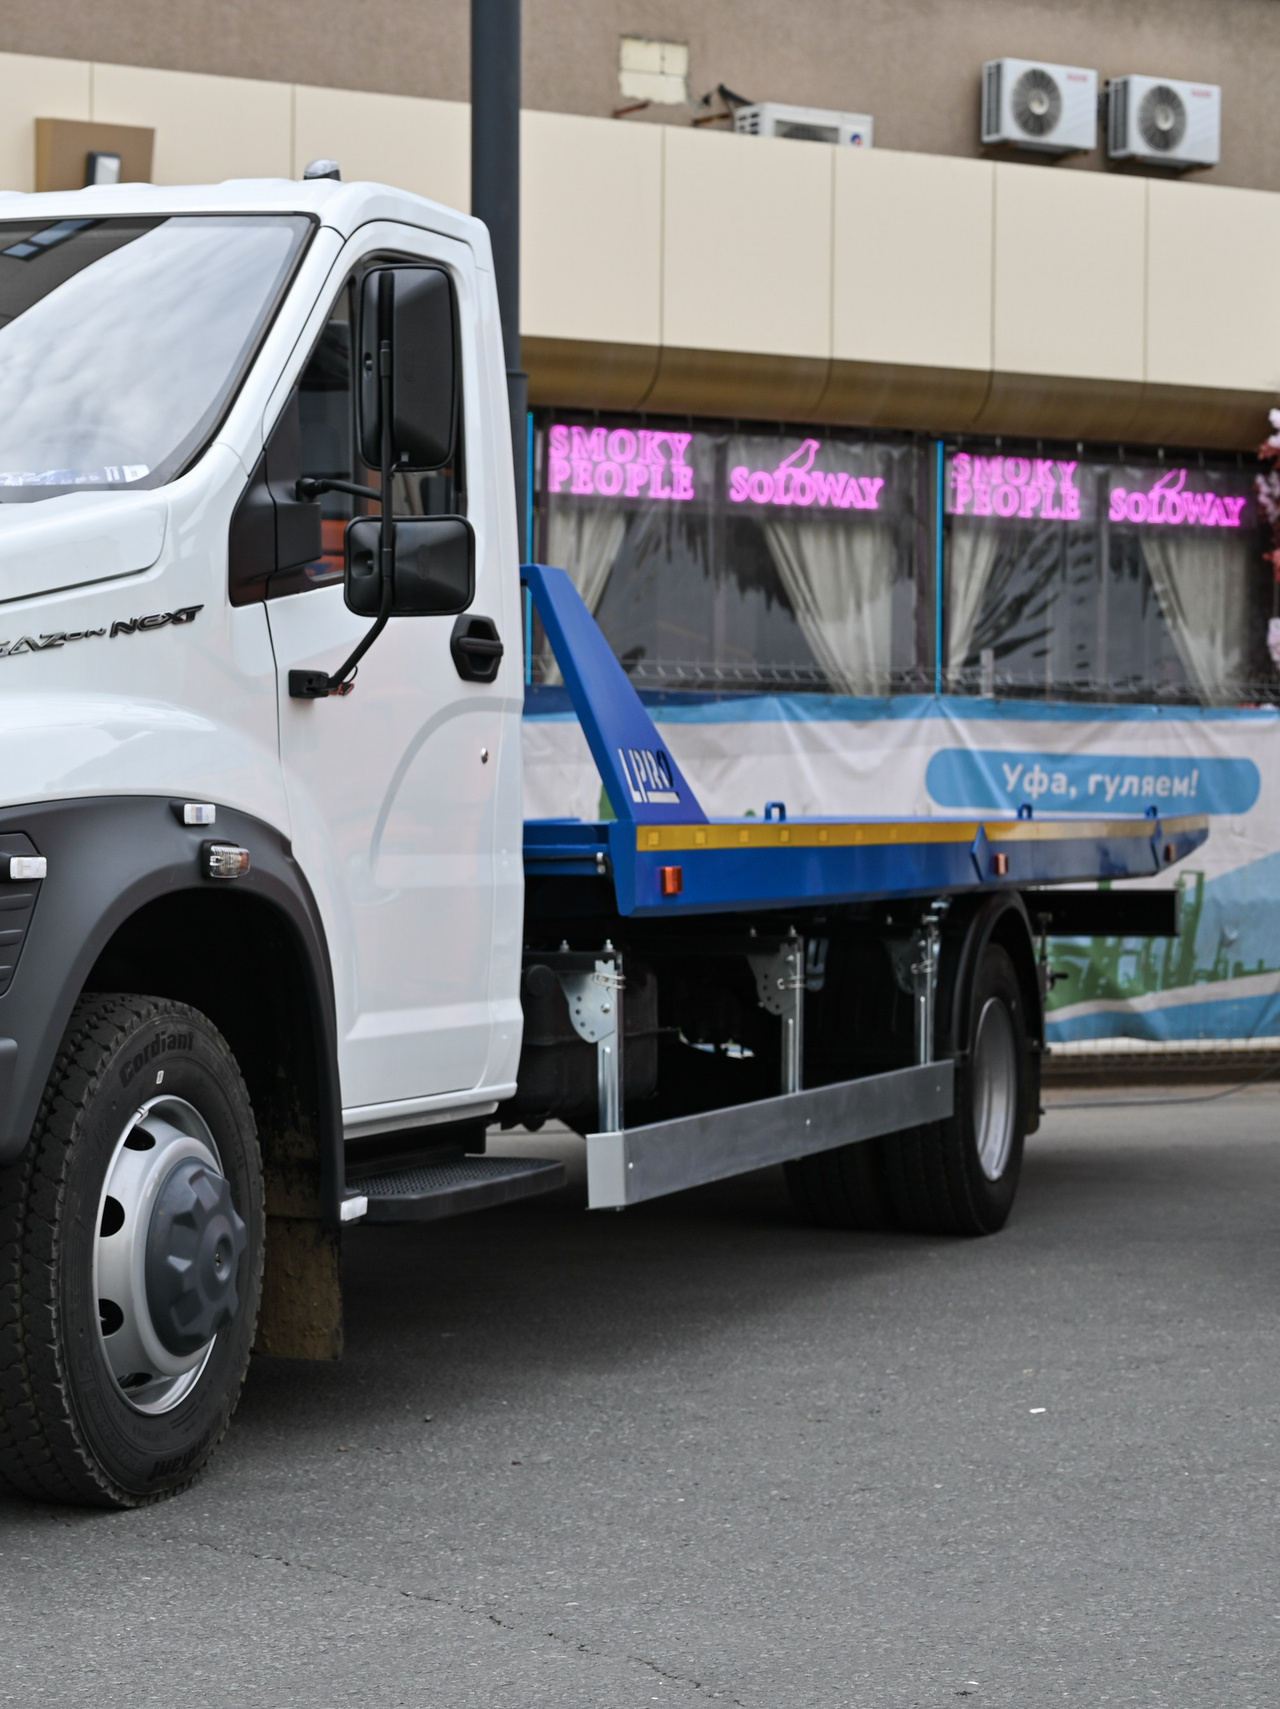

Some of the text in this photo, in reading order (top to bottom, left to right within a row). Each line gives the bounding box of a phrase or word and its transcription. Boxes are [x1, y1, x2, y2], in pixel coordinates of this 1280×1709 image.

[548, 424, 693, 466] SMOKY
[548, 458, 694, 500] PEOPLE
[729, 466, 884, 509] SOLOWAY
[953, 452, 1078, 488] SMOKY
[951, 484, 1081, 520] PEOPLE
[1109, 487, 1246, 527] SOLOWAY
[1002, 762, 1199, 802] Уфа, гуляем!
[120, 1030, 195, 1089] Cordiant
